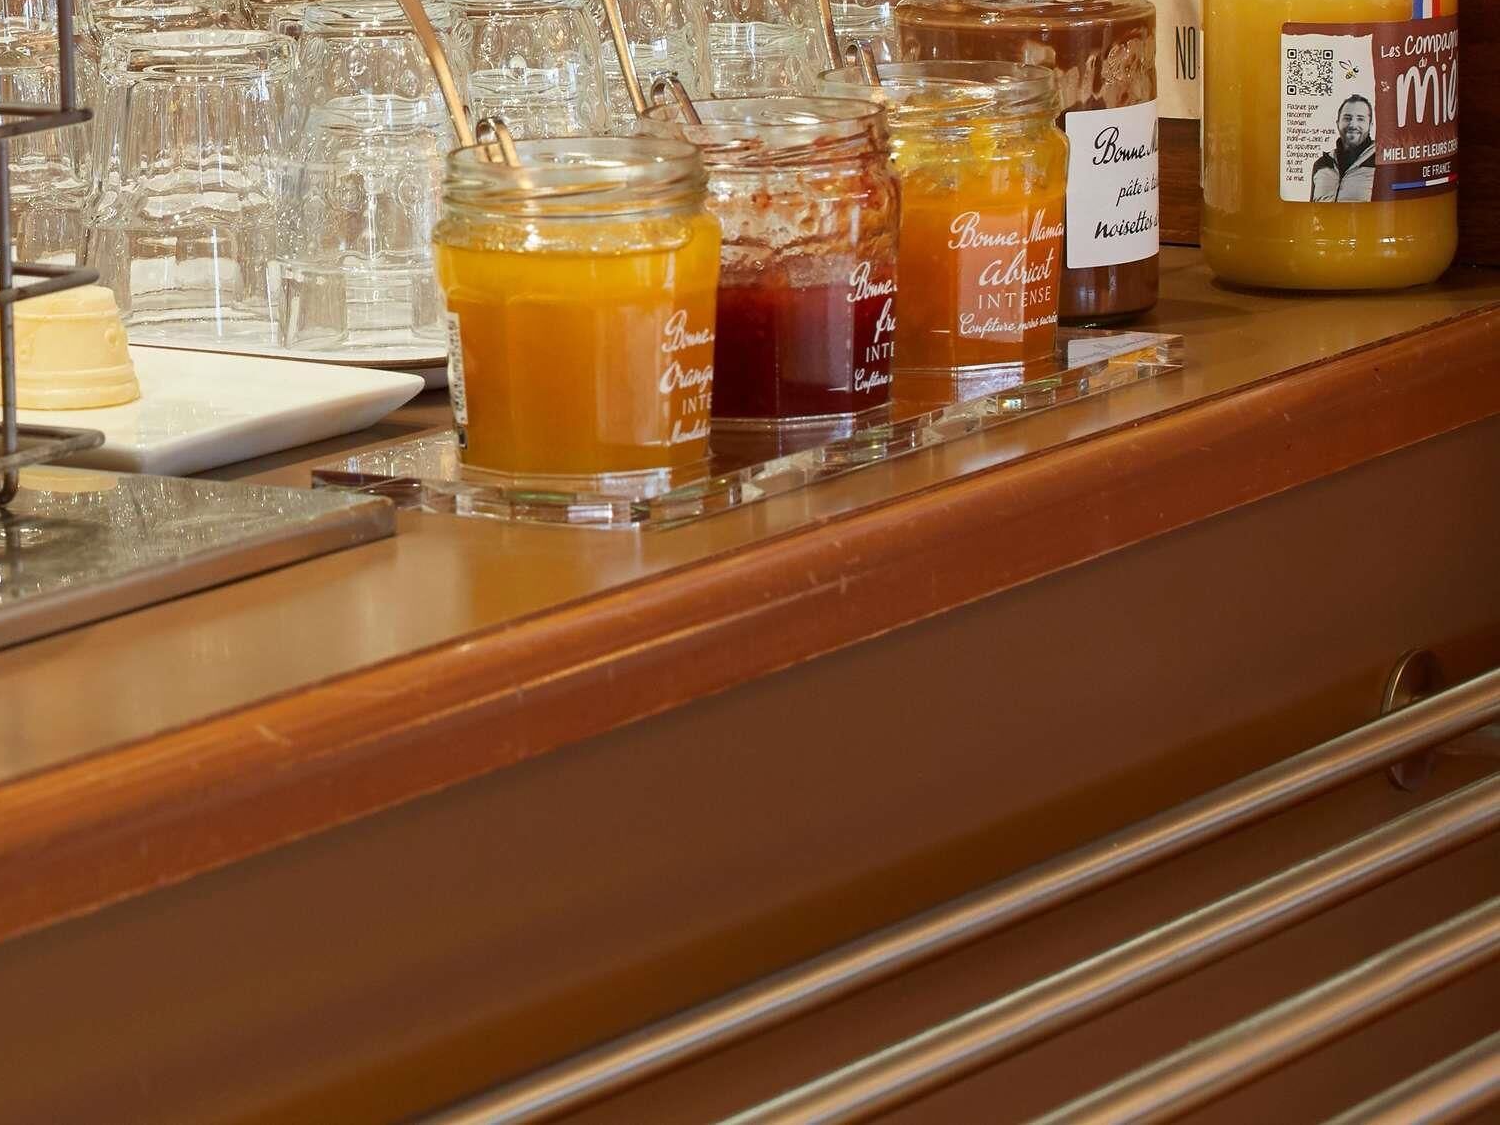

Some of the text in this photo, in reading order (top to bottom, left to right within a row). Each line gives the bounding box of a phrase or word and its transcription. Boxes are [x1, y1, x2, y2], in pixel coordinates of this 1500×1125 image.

[1175, 26, 1197, 81] NO
[1381, 28, 1458, 63] Les Compagn
[1092, 126, 1146, 166] Bonne
[1383, 147, 1406, 161] MIEL
[1409, 146, 1420, 159] DE
[1422, 141, 1448, 158] FLEURS
[1422, 161, 1451, 178] DE FRANCE
[1115, 177, 1142, 207] pâte
[947, 210, 1020, 250] Bonne
[1094, 210, 1153, 239] noisettes
[846, 261, 893, 303] Bonne
[978, 285, 1052, 310] INTENSE
[661, 309, 710, 353] Bonne
[958, 312, 1017, 340] Confiture
